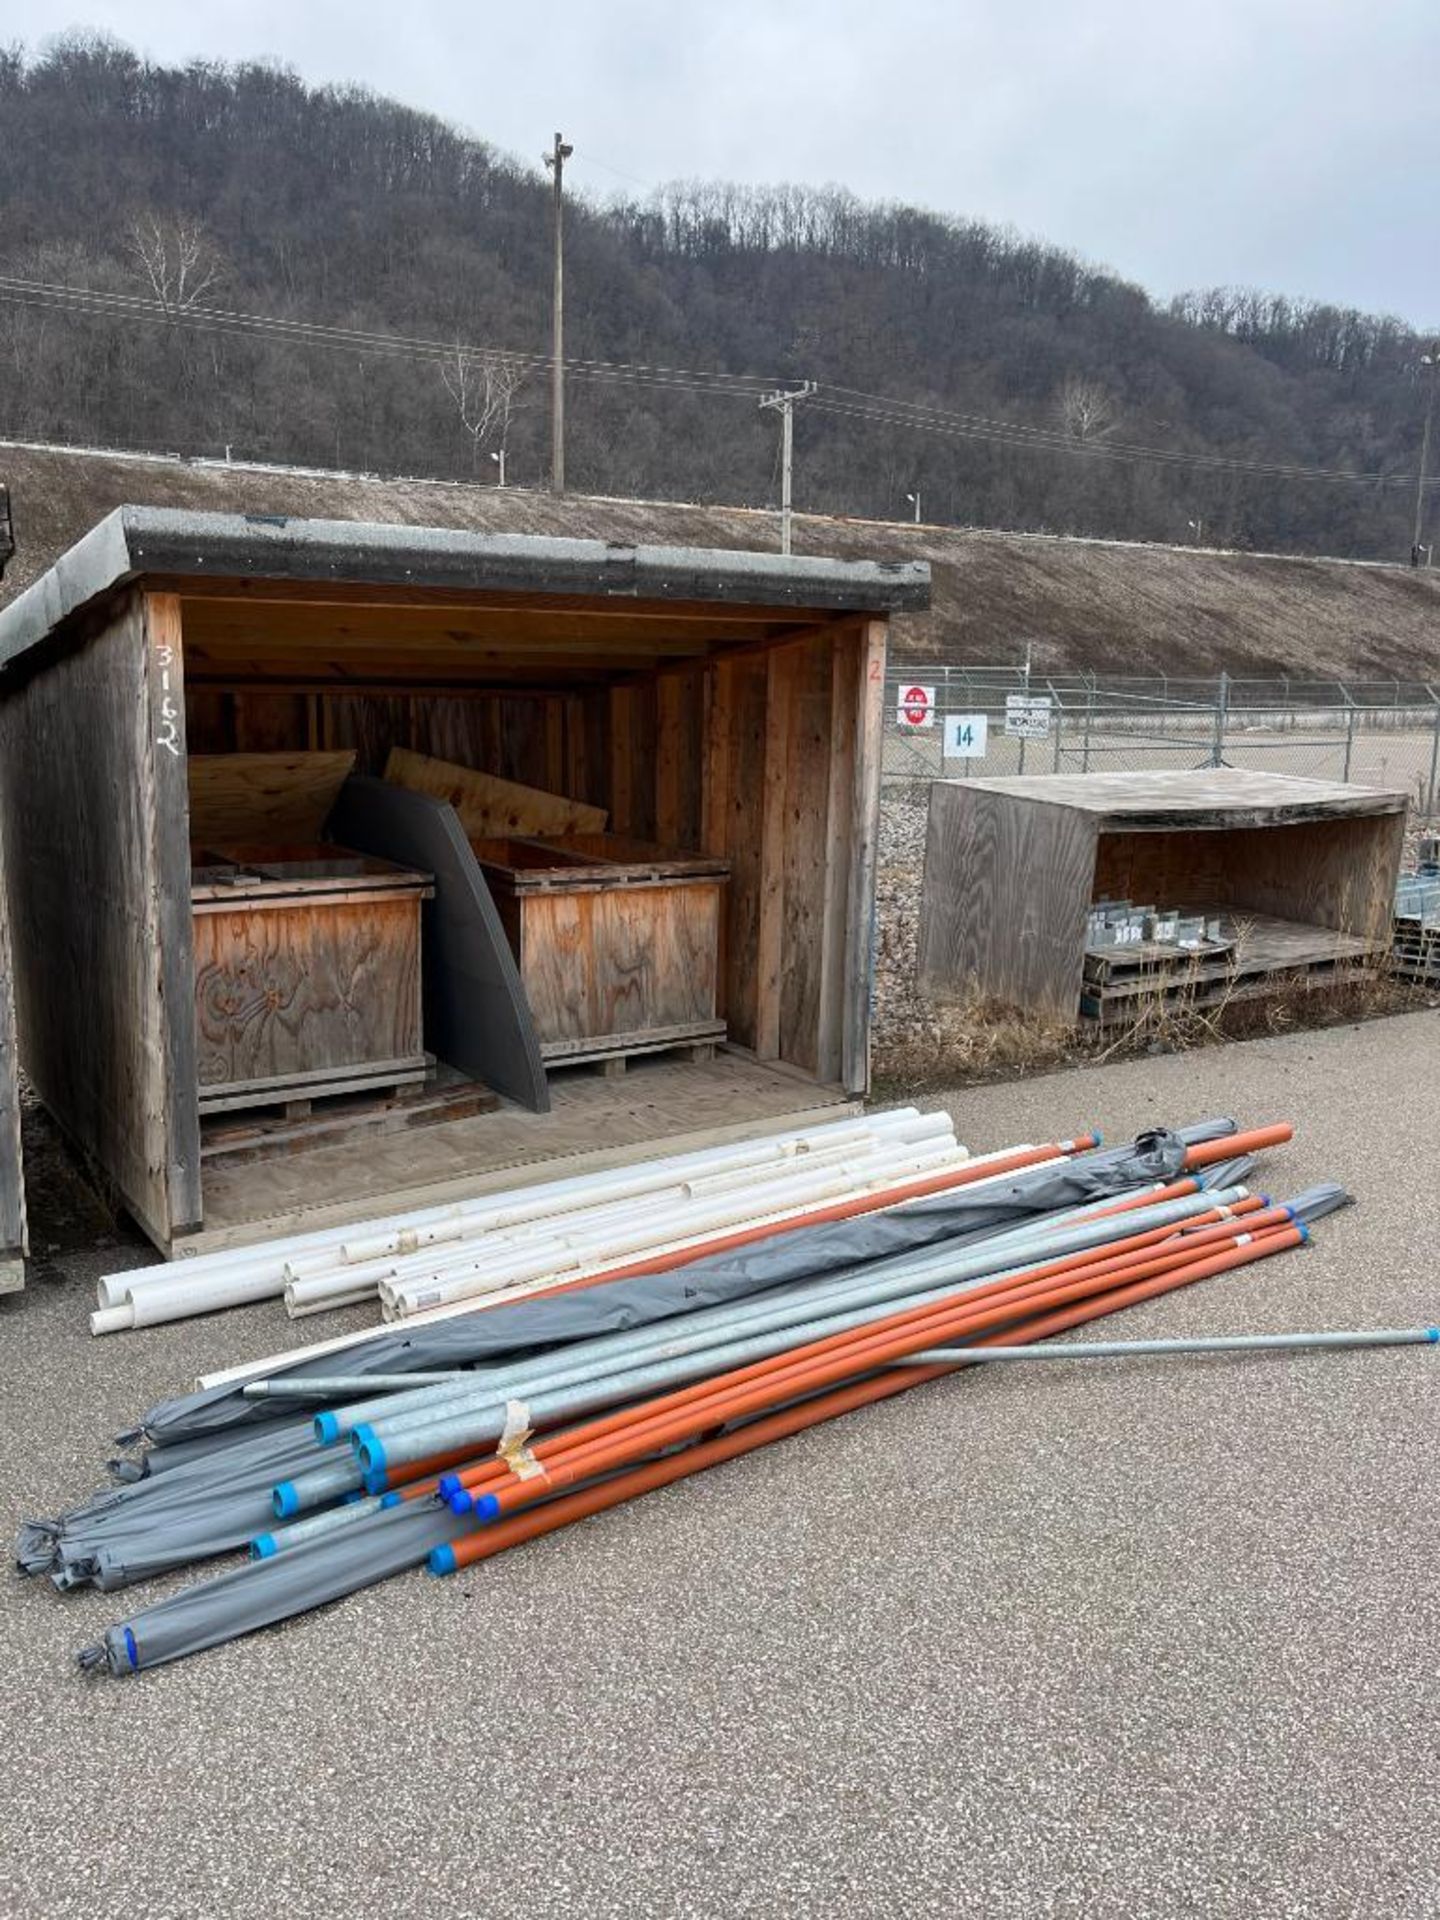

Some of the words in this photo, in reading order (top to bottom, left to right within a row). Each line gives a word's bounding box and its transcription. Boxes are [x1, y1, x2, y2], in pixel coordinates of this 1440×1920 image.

[869, 660, 881, 681] 2
[155, 645, 180, 755] 3162
[956, 724, 974, 747] 14
